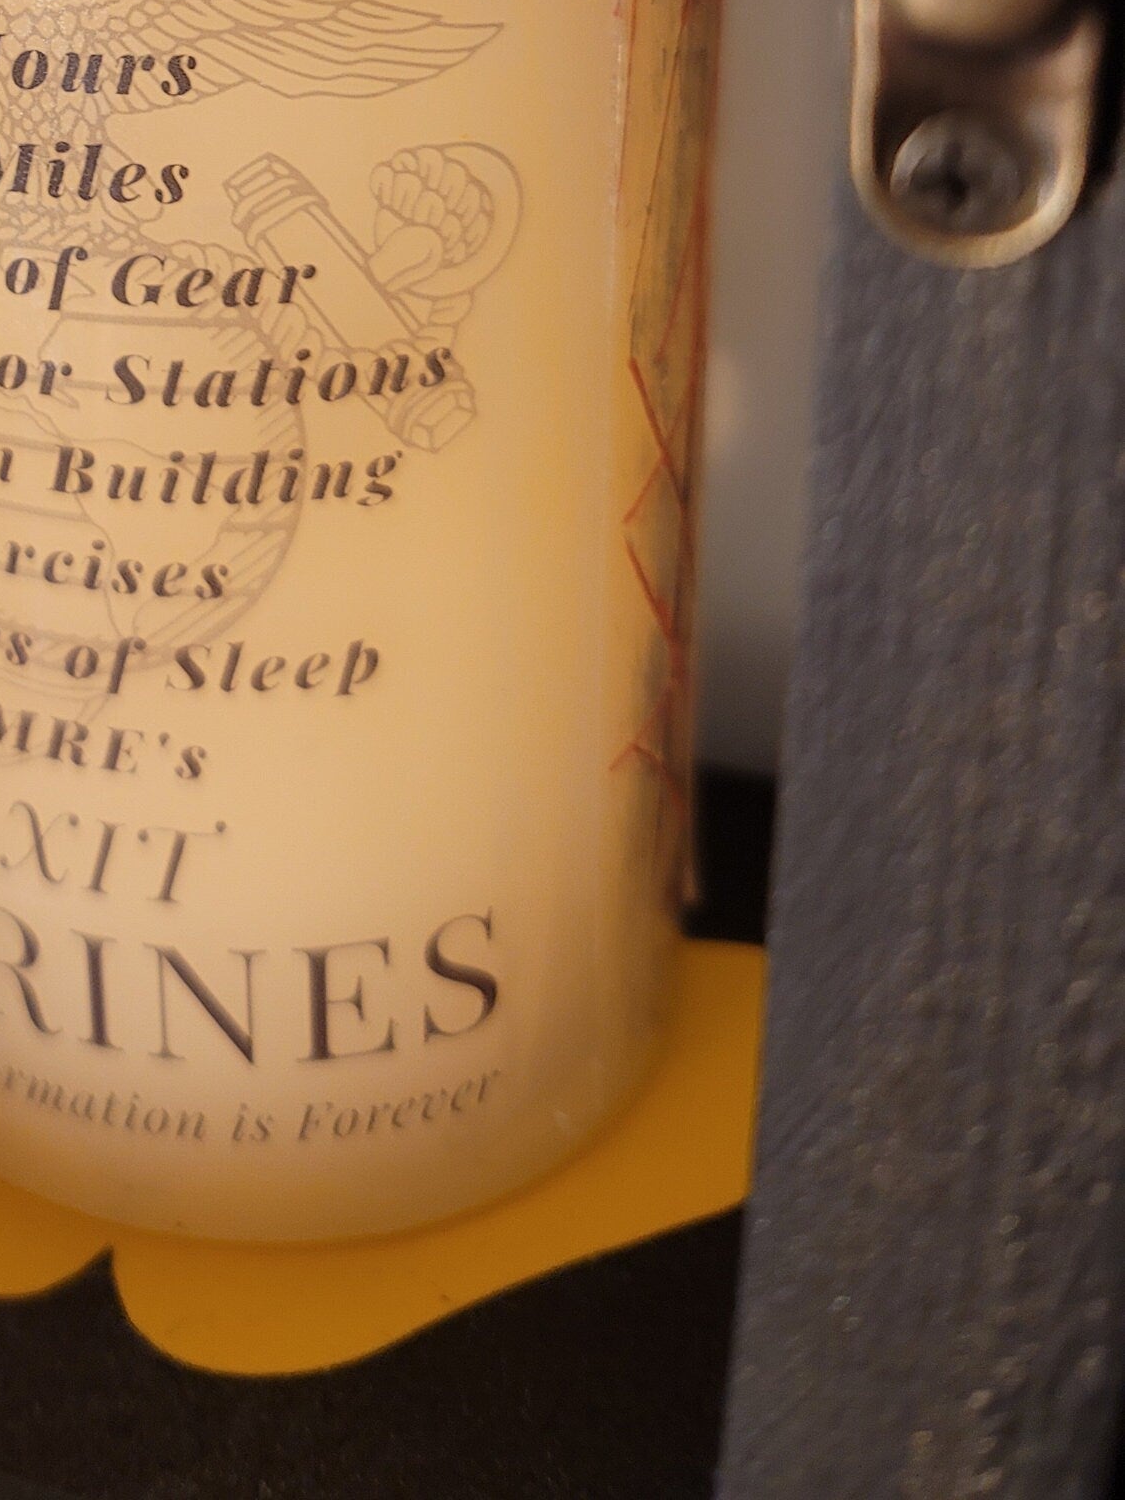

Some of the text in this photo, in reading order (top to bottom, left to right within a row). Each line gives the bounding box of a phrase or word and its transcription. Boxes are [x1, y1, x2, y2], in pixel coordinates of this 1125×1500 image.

[4, 244, 88, 312] of
[109, 253, 319, 309] Gear
[103, 342, 455, 410] Stations
[50, 448, 406, 509] Building
[63, 635, 148, 696] of
[164, 638, 382, 700] Sleep
[230, 1098, 275, 1147] is
[296, 1064, 505, 1146] Forever
